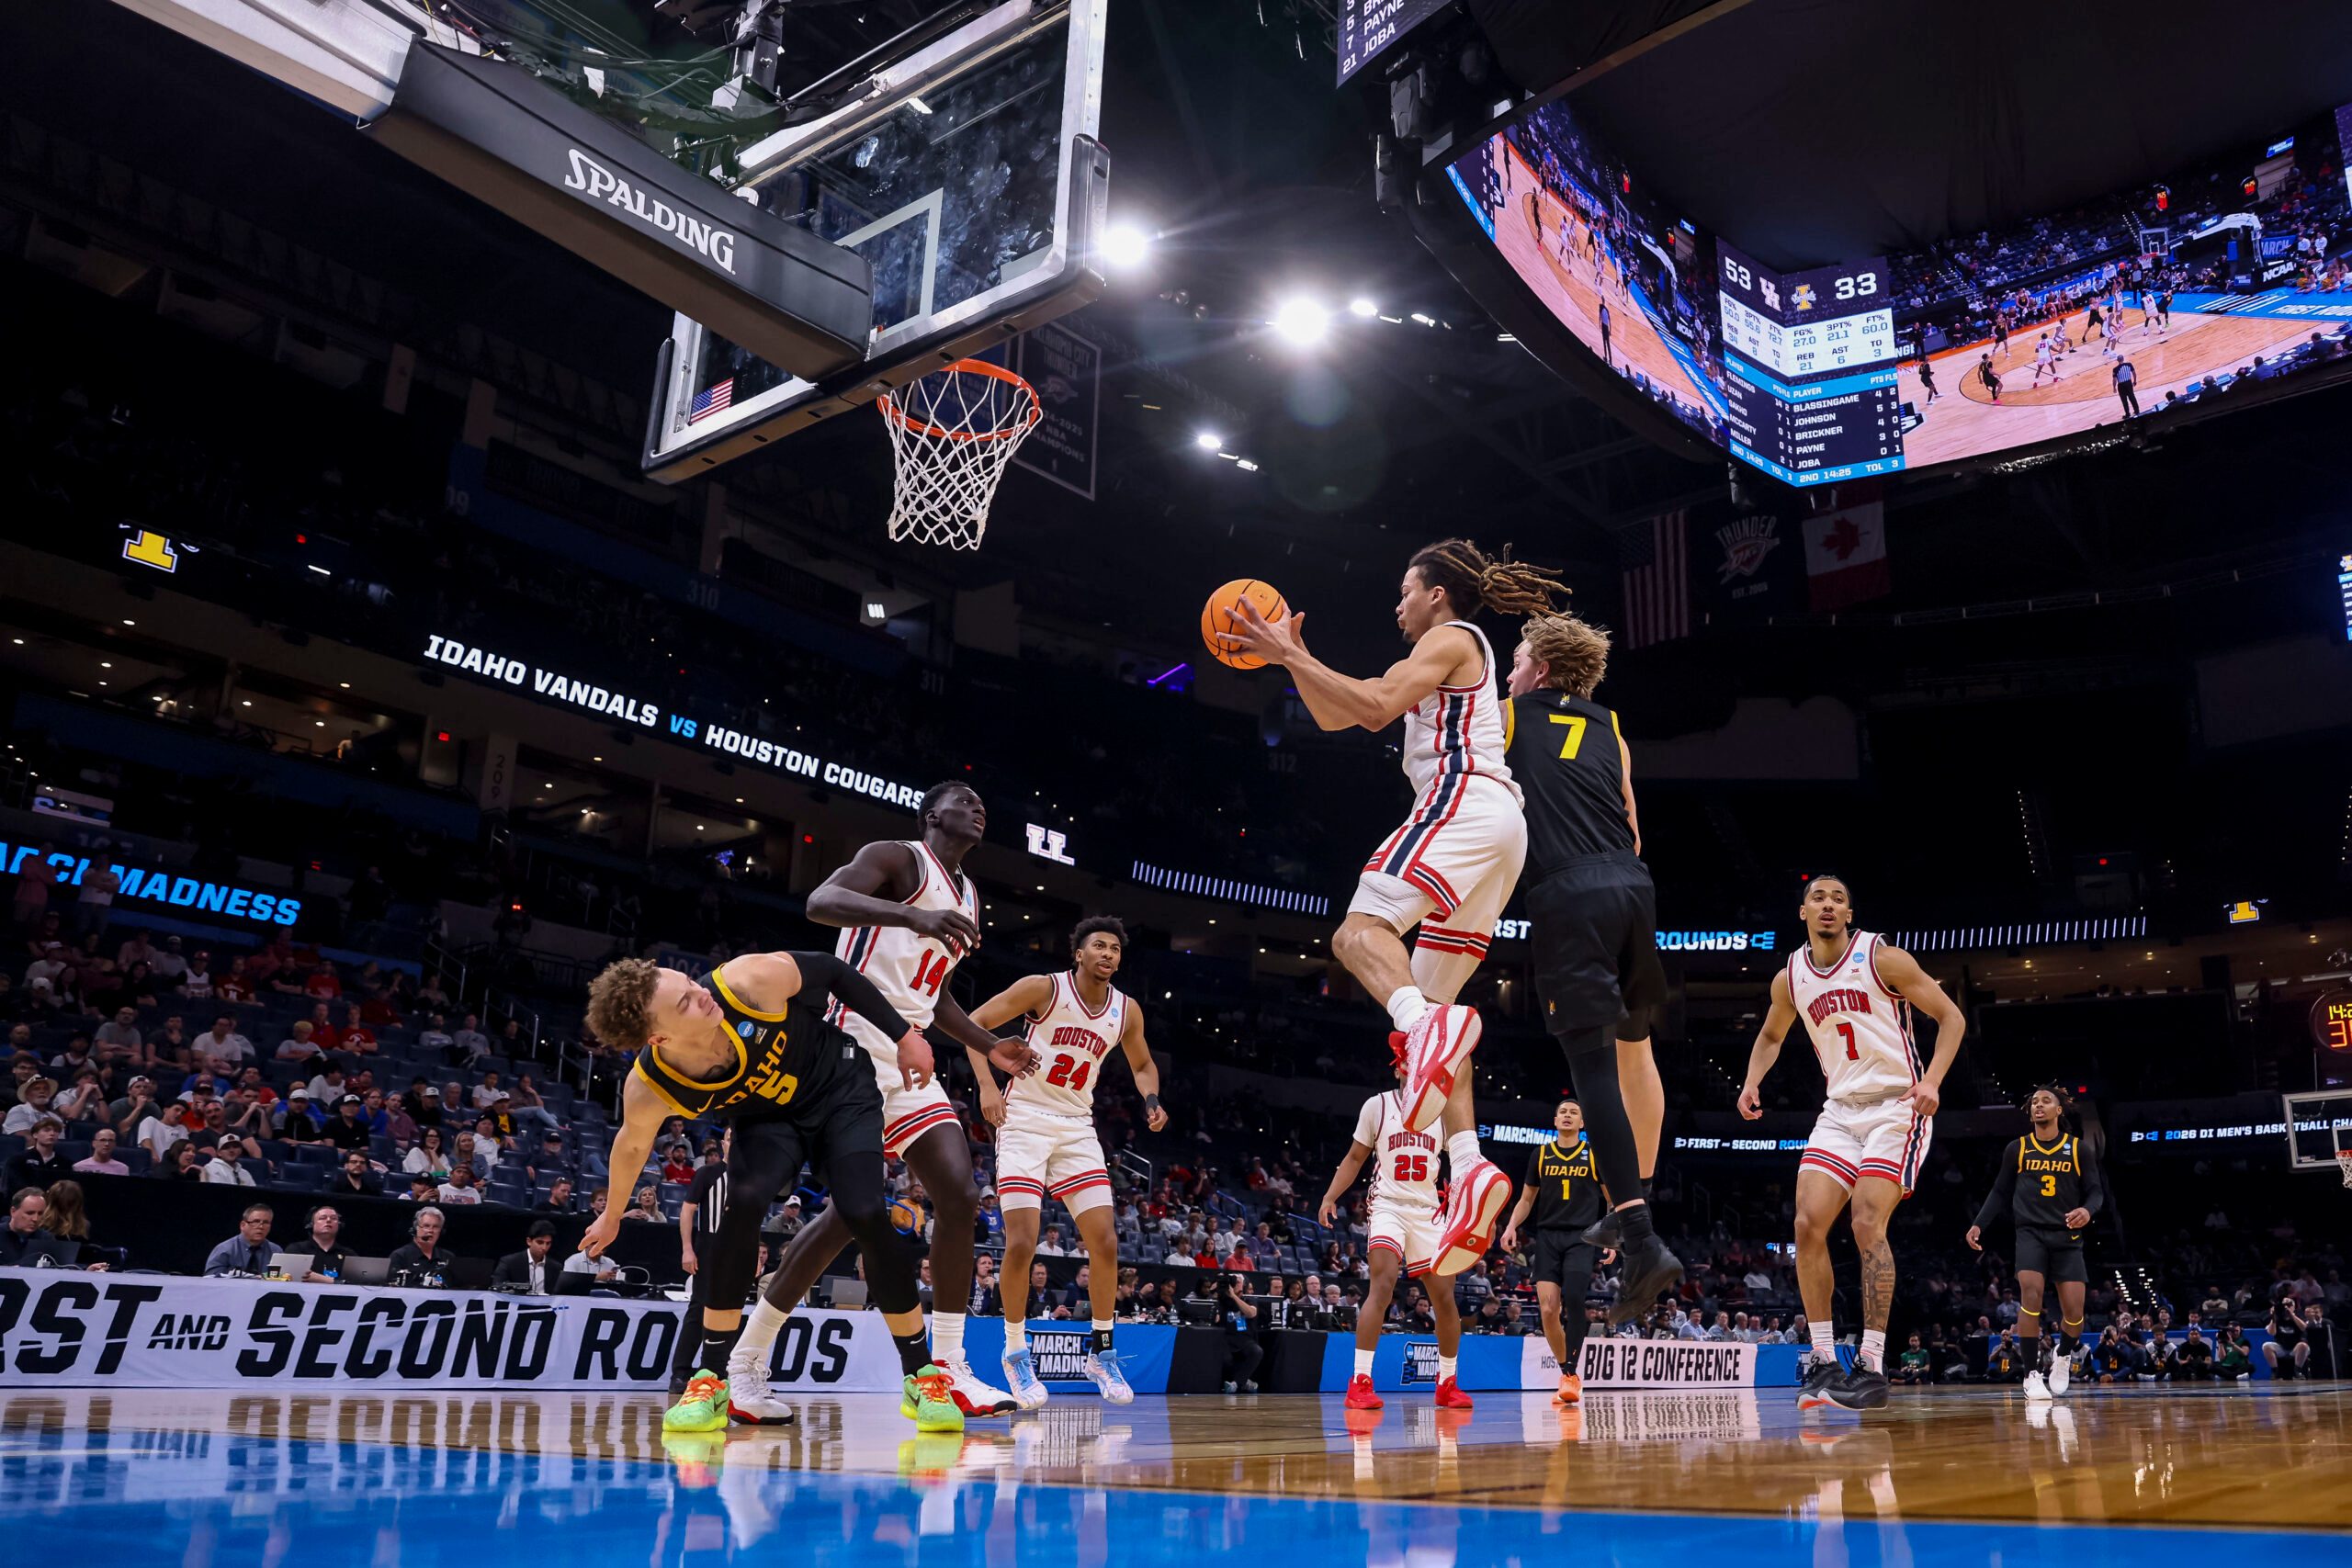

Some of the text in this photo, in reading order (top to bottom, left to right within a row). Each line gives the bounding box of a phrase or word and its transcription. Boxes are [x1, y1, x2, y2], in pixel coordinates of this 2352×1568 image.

[1346, 0, 1405, 50] 7 PAYNE
[1347, 15, 1354, 31] 5
[1343, 22, 1396, 74] 21 JOBA
[565, 149, 736, 275] SPALDING
[1724, 256, 1752, 291] 53
[1835, 272, 1877, 300] 33
[1792, 322, 1888, 347] 27.0 21.1 60.0
[1793, 314, 1885, 337] FG% 3PT% FT%
[1796, 339, 1883, 361] REB AST TO
[1800, 362, 1814, 371] 21
[1873, 349, 1882, 357] 3
[1726, 371, 1756, 394] FLEMINGS
[1727, 385, 1743, 400] UZAN
[1793, 373, 1898, 398] PLAYER PTS FLS
[1793, 387, 1896, 412] BLASSINGAME 4 2
[1729, 413, 1757, 435] MCCARTY
[1794, 401, 1897, 427] JOHNSON 5 3
[1046, 423, 1067, 442] NBA
[1730, 428, 1752, 446] MILLER
[1795, 415, 1898, 441] BRICKNER 4 0
[1796, 430, 1900, 455] PAYNE 3 0
[1797, 445, 1901, 469] JOBA 0 1
[1771, 465, 1783, 477] TOL
[1799, 460, 1899, 483] 2ND 14:25 TOL 3
[1714, 515, 1777, 548] THUNDER
[424, 634, 926, 811] IDAHO VANDALS VS HOUSTON COUGARS
[1549, 714, 1587, 759] 7
[109, 864, 301, 927] MADNESS
[1494, 919, 1532, 940] RST
[909, 948, 949, 998] 14
[1807, 988, 1872, 1028] HOUSTON
[1050, 1027, 1108, 1061] HOUSTON
[1836, 1021, 1860, 1061] 7
[1046, 1054, 1091, 1091] 24
[756, 1070, 798, 1106] 5
[1387, 1131, 1437, 1152] HOUSTON
[2165, 1130, 2197, 1140] 2026
[2199, 1129, 2214, 1138] DI
[2217, 1126, 2252, 1138] MEN'S
[2255, 1119, 2330, 1134] BASKTBALL
[1688, 1138, 1721, 1149] FIRST
[1732, 1140, 1776, 1150] SECOND
[1394, 1155, 1428, 1182] 25
[1544, 1165, 1589, 1178] IDAHO
[2026, 1159, 2072, 1172] IDAHO
[1561, 1179, 1570, 1201] 1
[2041, 1175, 2056, 1197] 3
[146, 1314, 232, 1350] AND
[235, 1292, 557, 1380] SECOND
[573, 1308, 854, 1383] RODS
[1033, 1336, 1080, 1353] MARCH
[1039, 1355, 1087, 1373] MADNE
[1583, 1344, 1741, 1382] BIG 12 CONFERENCE
